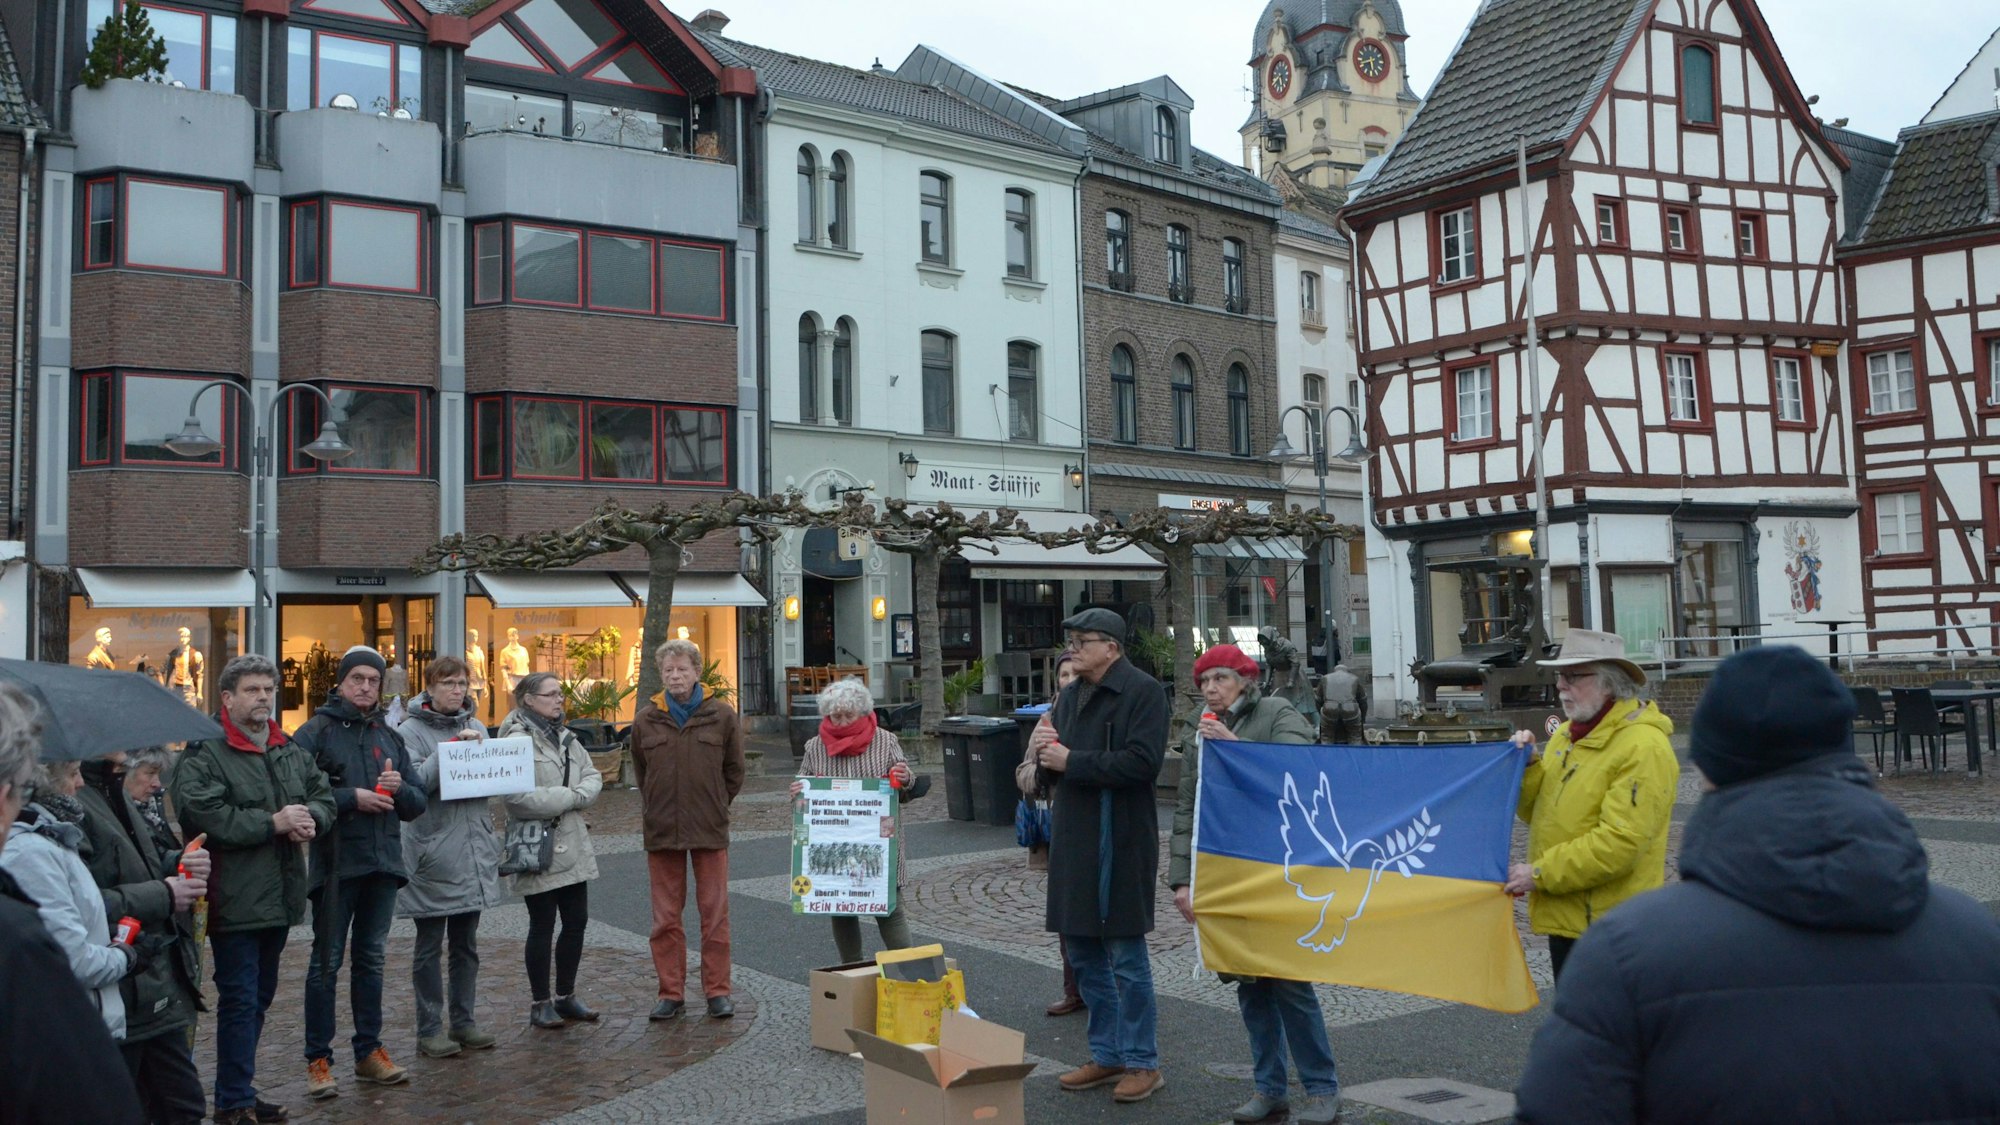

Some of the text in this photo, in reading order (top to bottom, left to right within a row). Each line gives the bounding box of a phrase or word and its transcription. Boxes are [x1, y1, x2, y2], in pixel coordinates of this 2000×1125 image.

[930, 469, 974, 490] Maat
[449, 766, 511, 780] Verhandeln
[811, 799, 882, 807] Waffen sind Scheiße
[811, 808, 821, 816] für
[811, 818, 850, 826] Gesundheit
[814, 889, 840, 897] überall
[869, 902, 888, 912] EGAL
